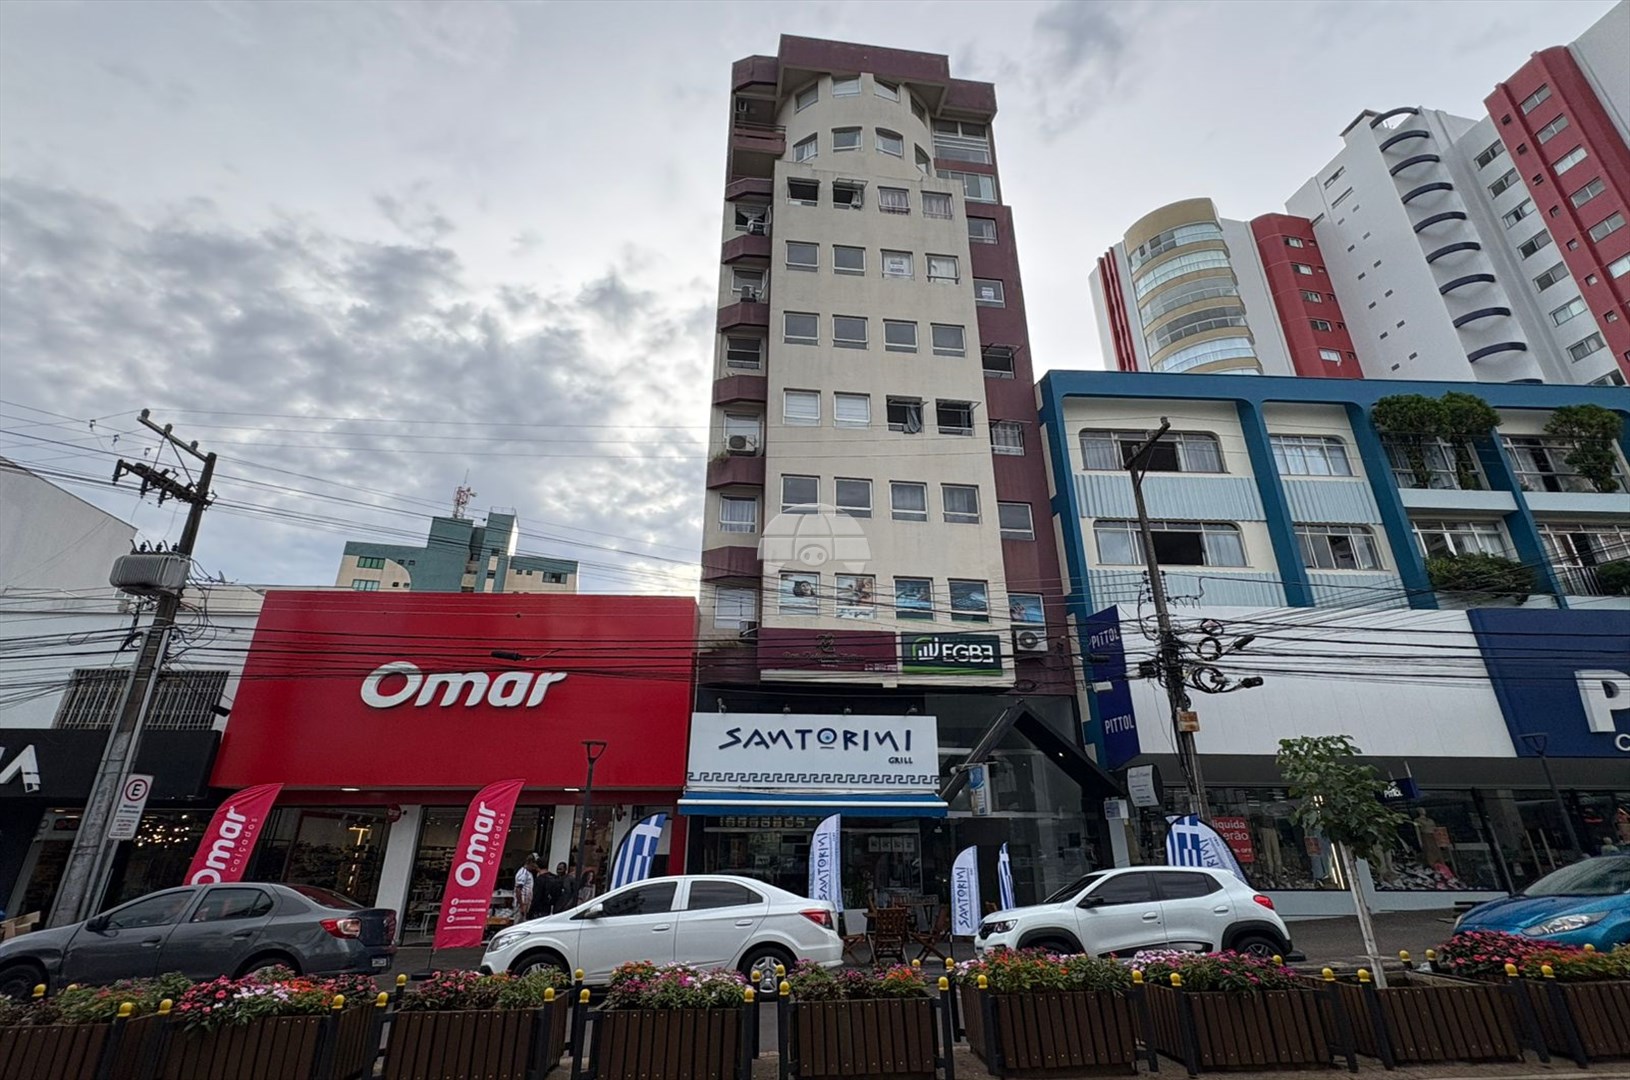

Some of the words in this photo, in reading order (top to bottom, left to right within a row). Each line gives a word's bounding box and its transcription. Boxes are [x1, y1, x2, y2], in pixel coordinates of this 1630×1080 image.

[1091, 627, 1120, 649] PITTOL
[360, 661, 568, 709] Omar
[718, 727, 911, 751] SANTORINI
[1104, 713, 1134, 734] PITTOL
[888, 756, 913, 764] GRILL
[131, 783, 142, 796] E
[191, 805, 246, 885] Omar
[455, 801, 496, 887] Omar
[487, 813, 505, 865] calçados
[1222, 831, 1249, 841] erão
[816, 832, 829, 900] SANTORINI
[955, 866, 971, 929] SANTORINI
